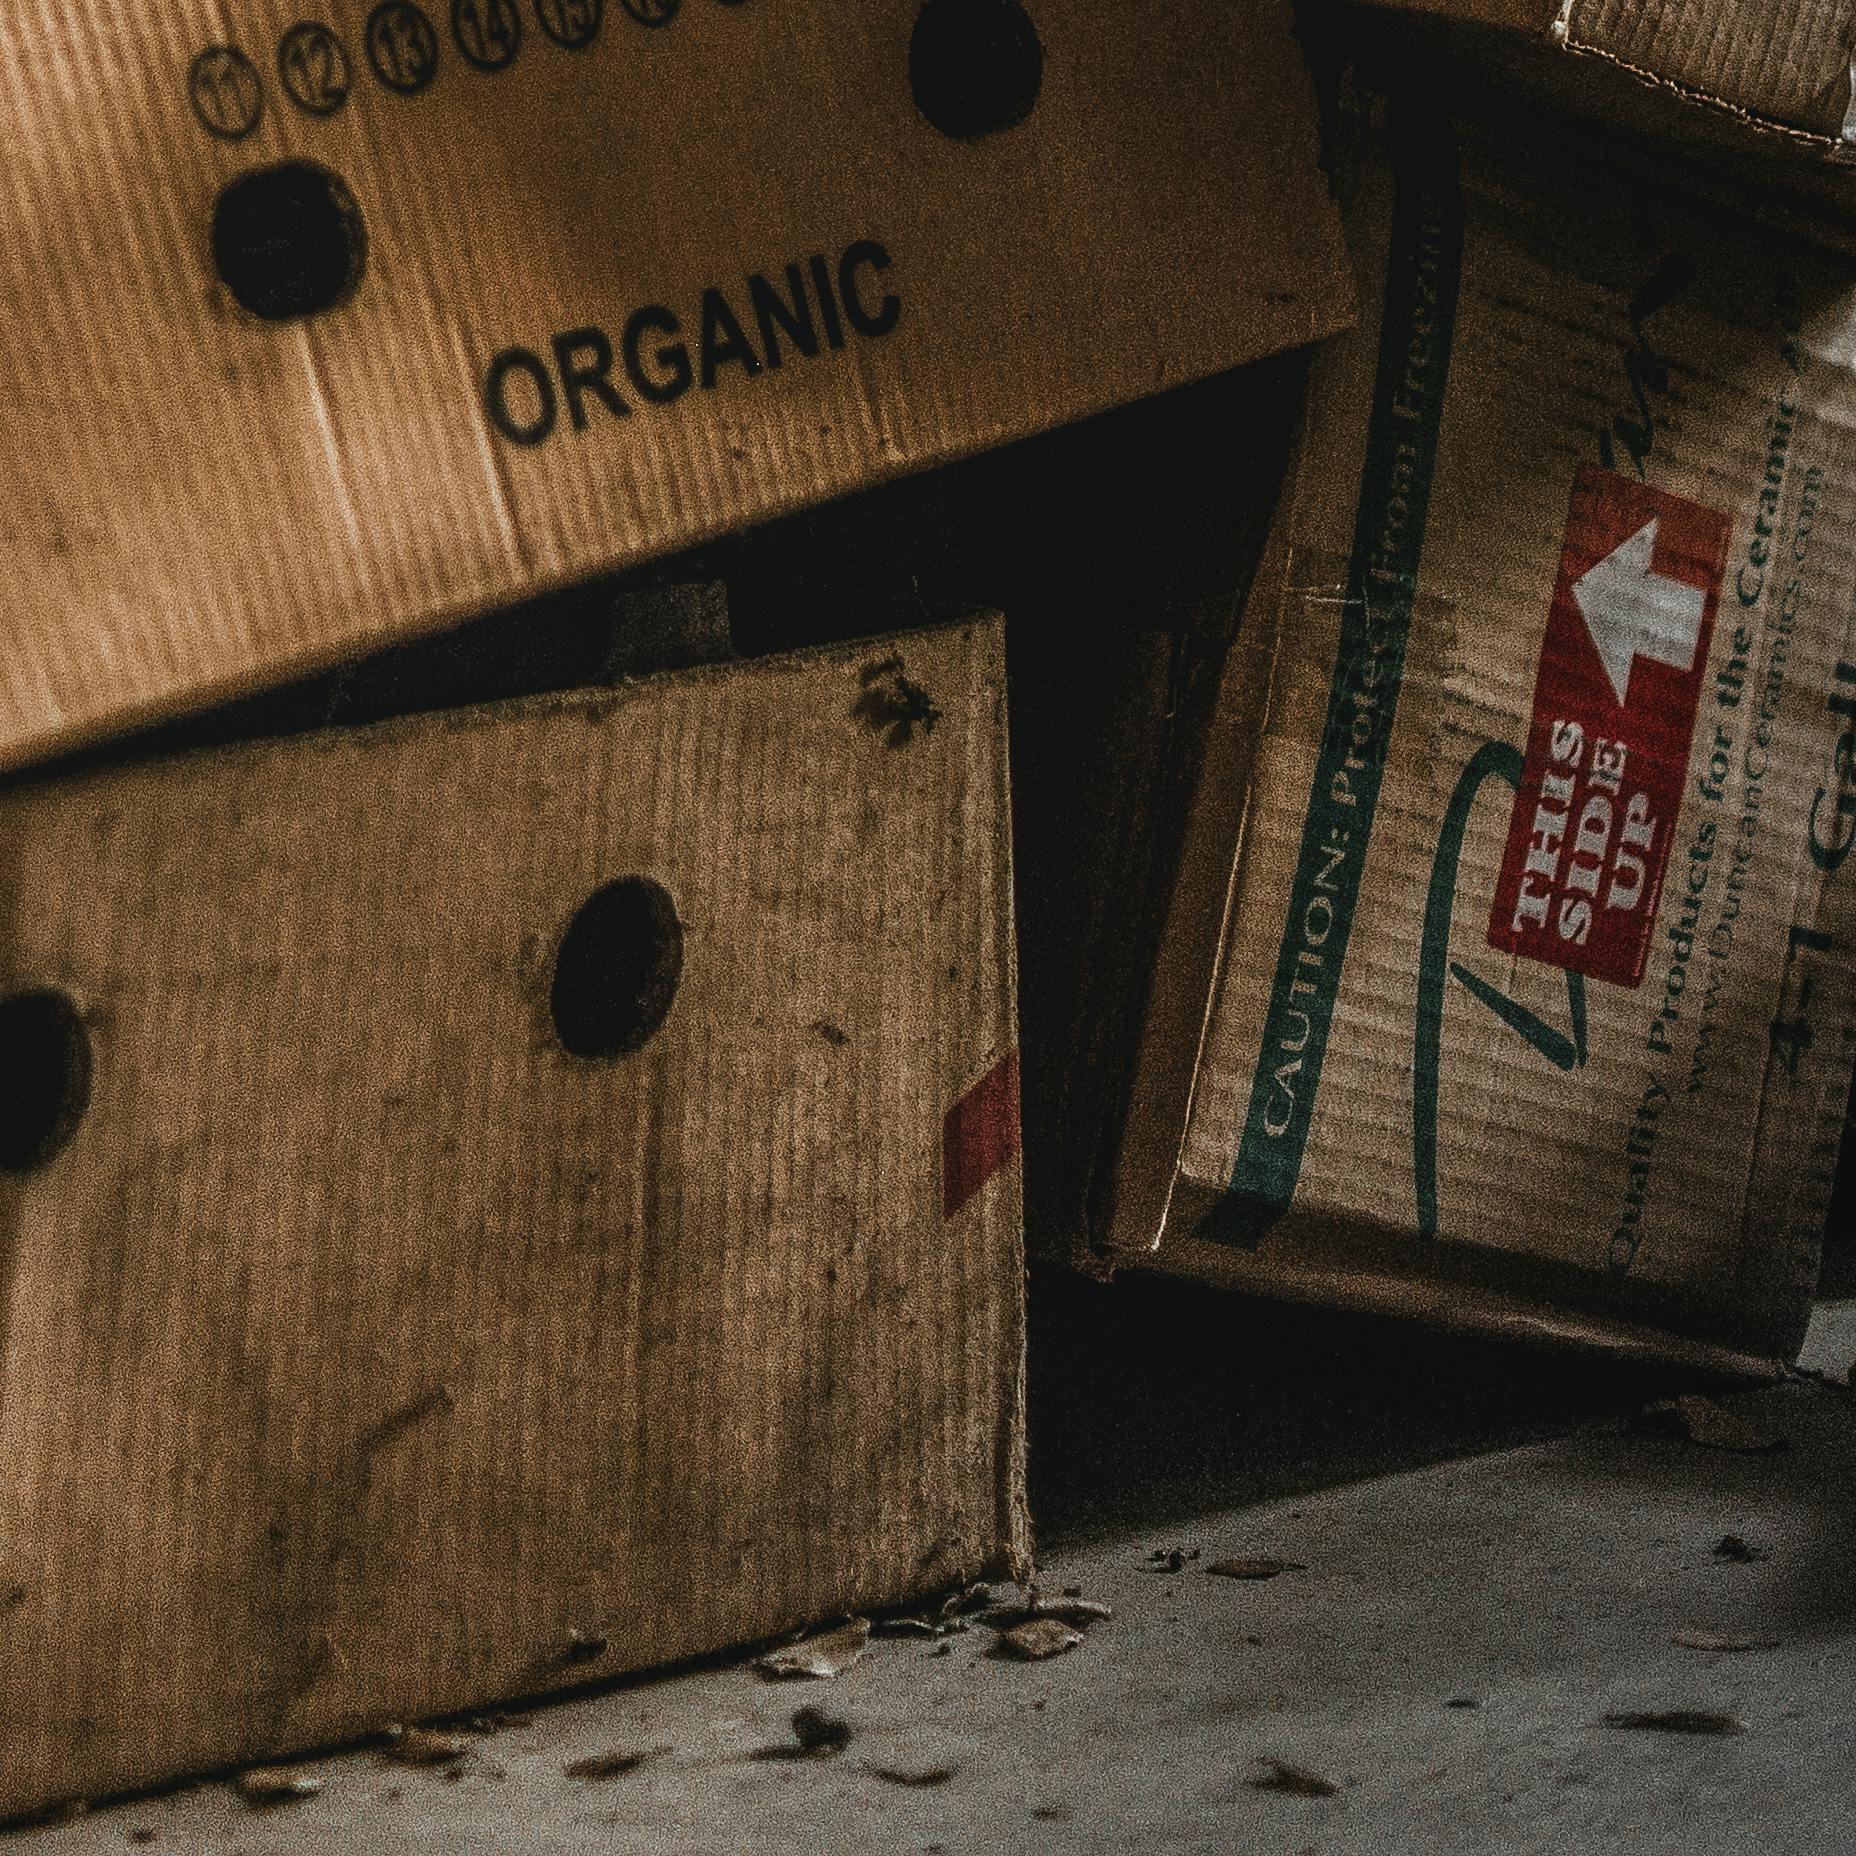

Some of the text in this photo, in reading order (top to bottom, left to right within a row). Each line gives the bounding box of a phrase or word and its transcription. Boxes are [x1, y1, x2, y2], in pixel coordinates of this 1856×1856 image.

[485, 237, 904, 448] ORGANIC
[1735, 385, 1800, 609] Ceramic
[1698, 718, 1737, 806] for
[1716, 624, 1753, 708] the
[1261, 827, 1352, 1140] CAUTION:
[1330, 607, 1396, 807] Protect
[1367, 446, 1421, 587] From
[1510, 719, 1586, 934] THIS
[1557, 736, 1631, 947] SIDE
[1605, 790, 1658, 913] UP
[1687, 461, 1824, 1094] www.DuncanCeramics.com
[1646, 820, 1718, 1055] Products
[1770, 926, 1833, 1075] 4-1
[1605, 1076, 1673, 1281] Quality
